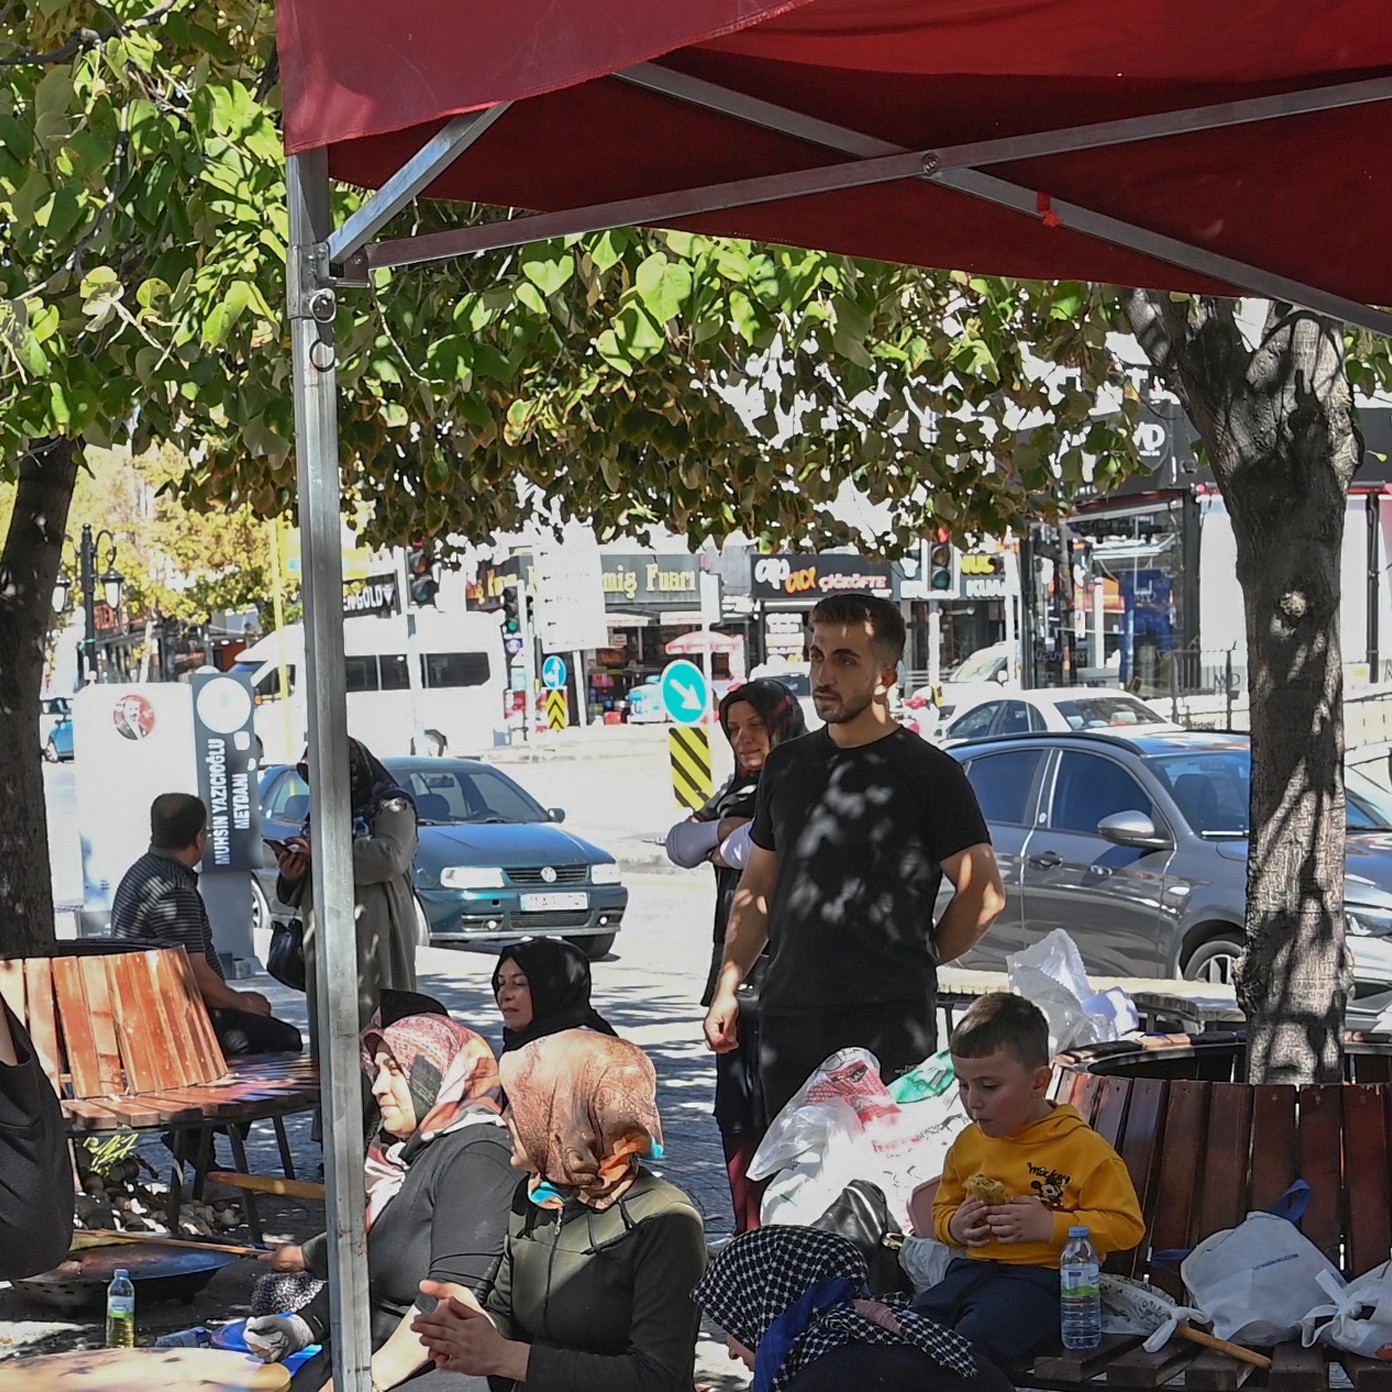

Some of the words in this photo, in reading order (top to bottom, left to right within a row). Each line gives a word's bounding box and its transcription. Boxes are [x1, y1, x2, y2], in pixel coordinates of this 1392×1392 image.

[205, 738, 228, 815] YAZICIOĞLU
[231, 773, 251, 830] MEYDANI
[208, 815, 231, 865] MUHSİN
